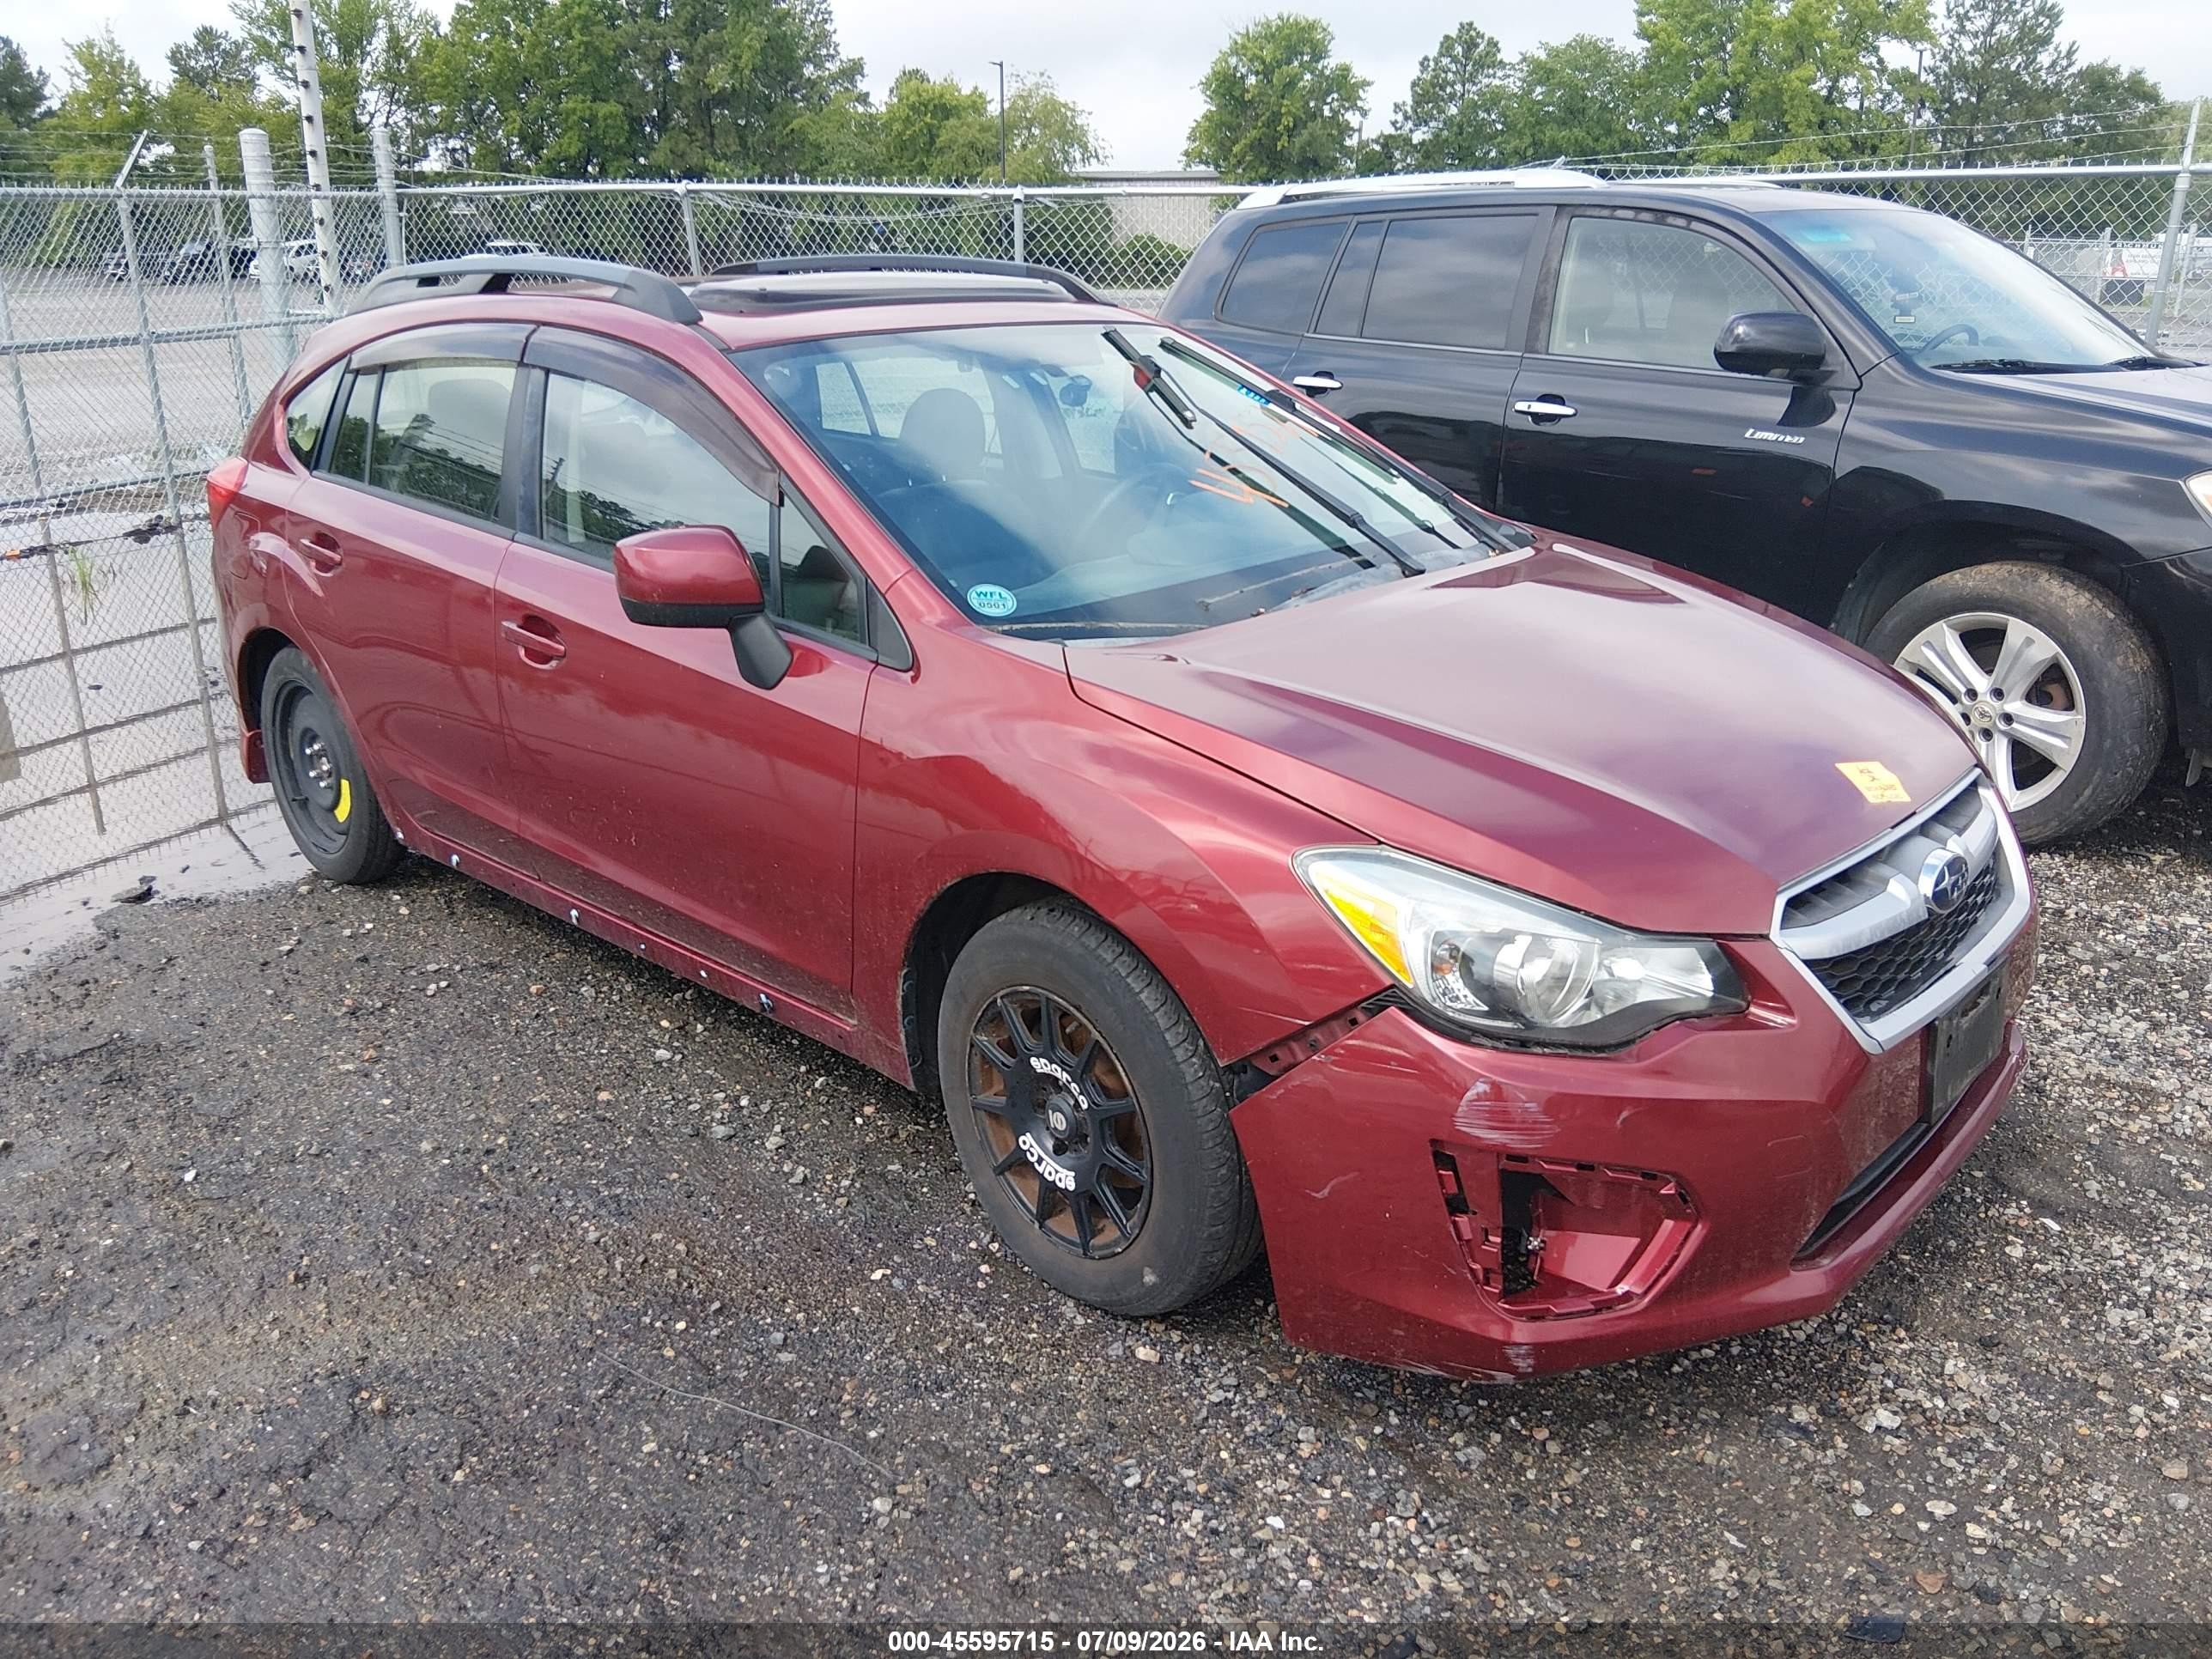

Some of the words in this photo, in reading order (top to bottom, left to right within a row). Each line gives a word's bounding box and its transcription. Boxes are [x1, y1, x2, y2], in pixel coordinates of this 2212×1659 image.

[975, 590, 1006, 600] WFL
[1030, 1055, 1089, 1110] sparco
[1018, 1133, 1076, 1192] sparco
